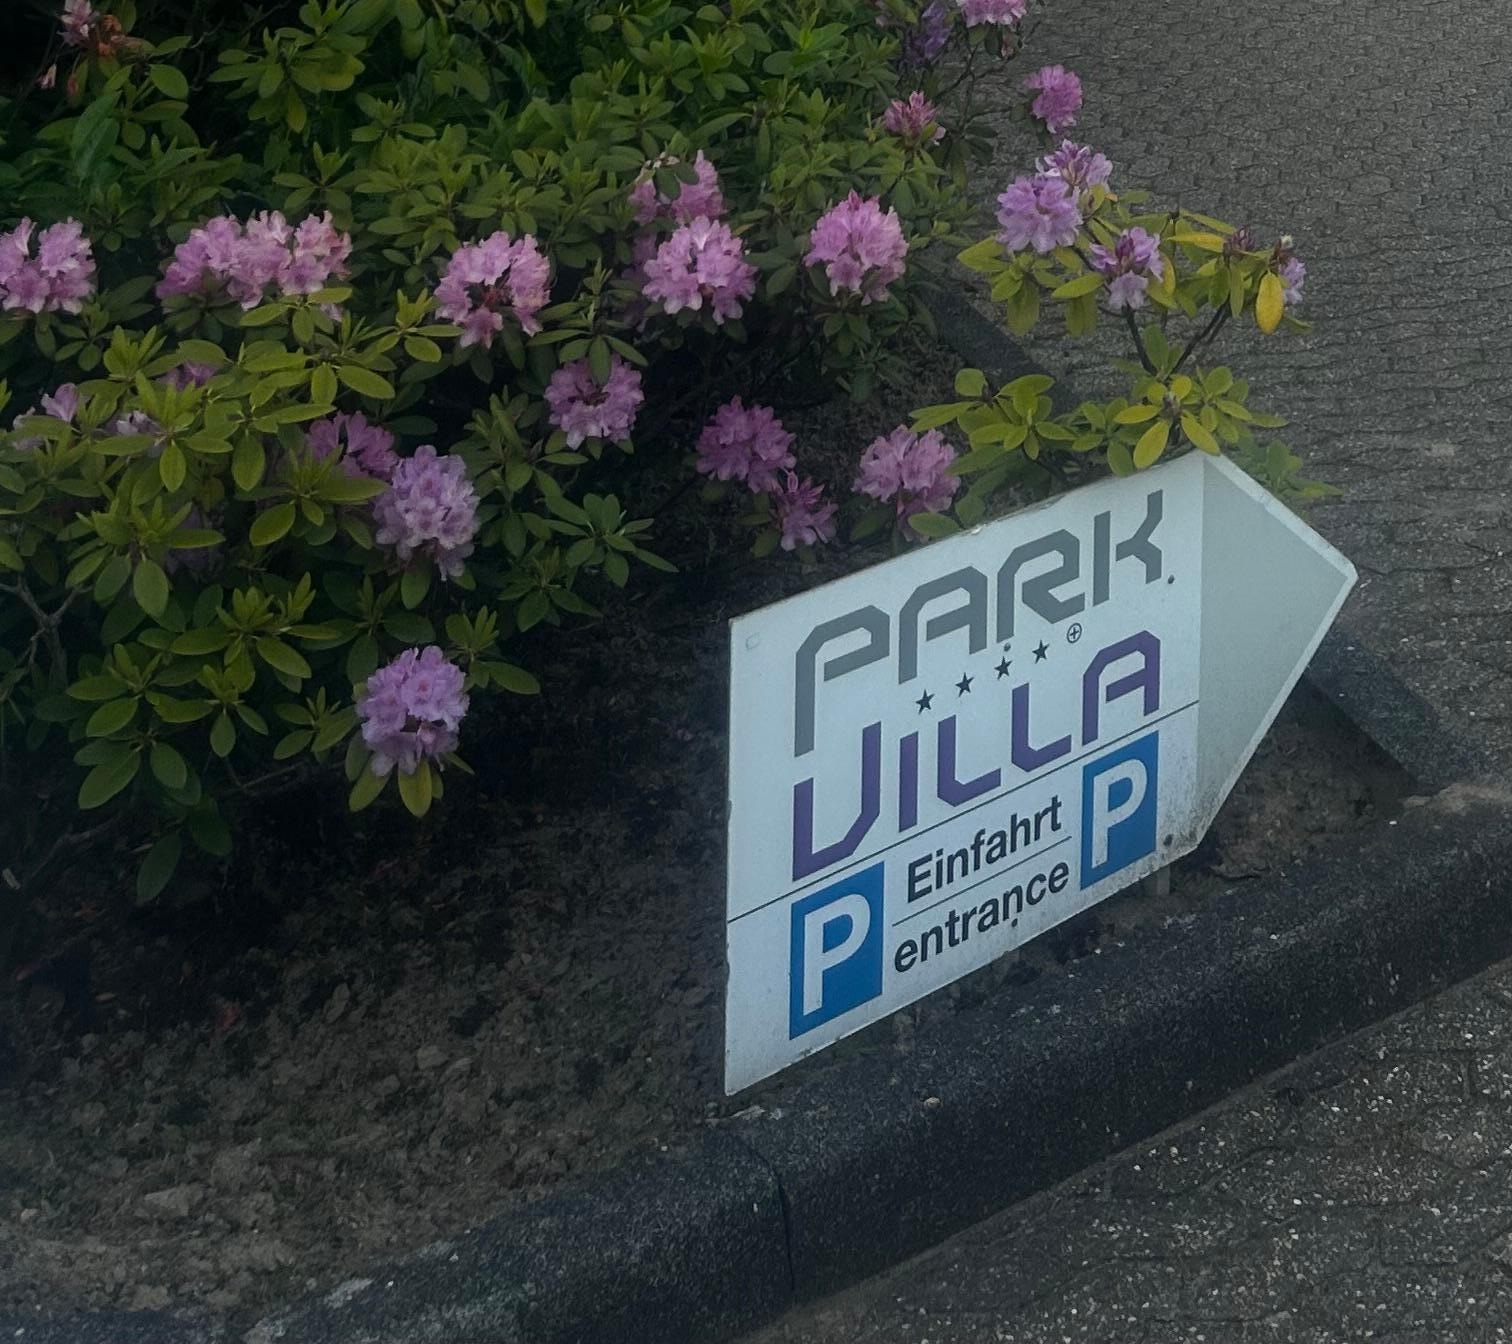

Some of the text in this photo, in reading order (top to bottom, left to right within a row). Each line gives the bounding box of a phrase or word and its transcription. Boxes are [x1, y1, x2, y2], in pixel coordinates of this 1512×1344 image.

[793, 489, 1164, 758] PARK
[792, 630, 1161, 882] VILLA
[1091, 757, 1149, 869] P
[906, 795, 1062, 904] Einfahrt
[802, 896, 872, 1015] P
[894, 859, 1070, 974] entrance
